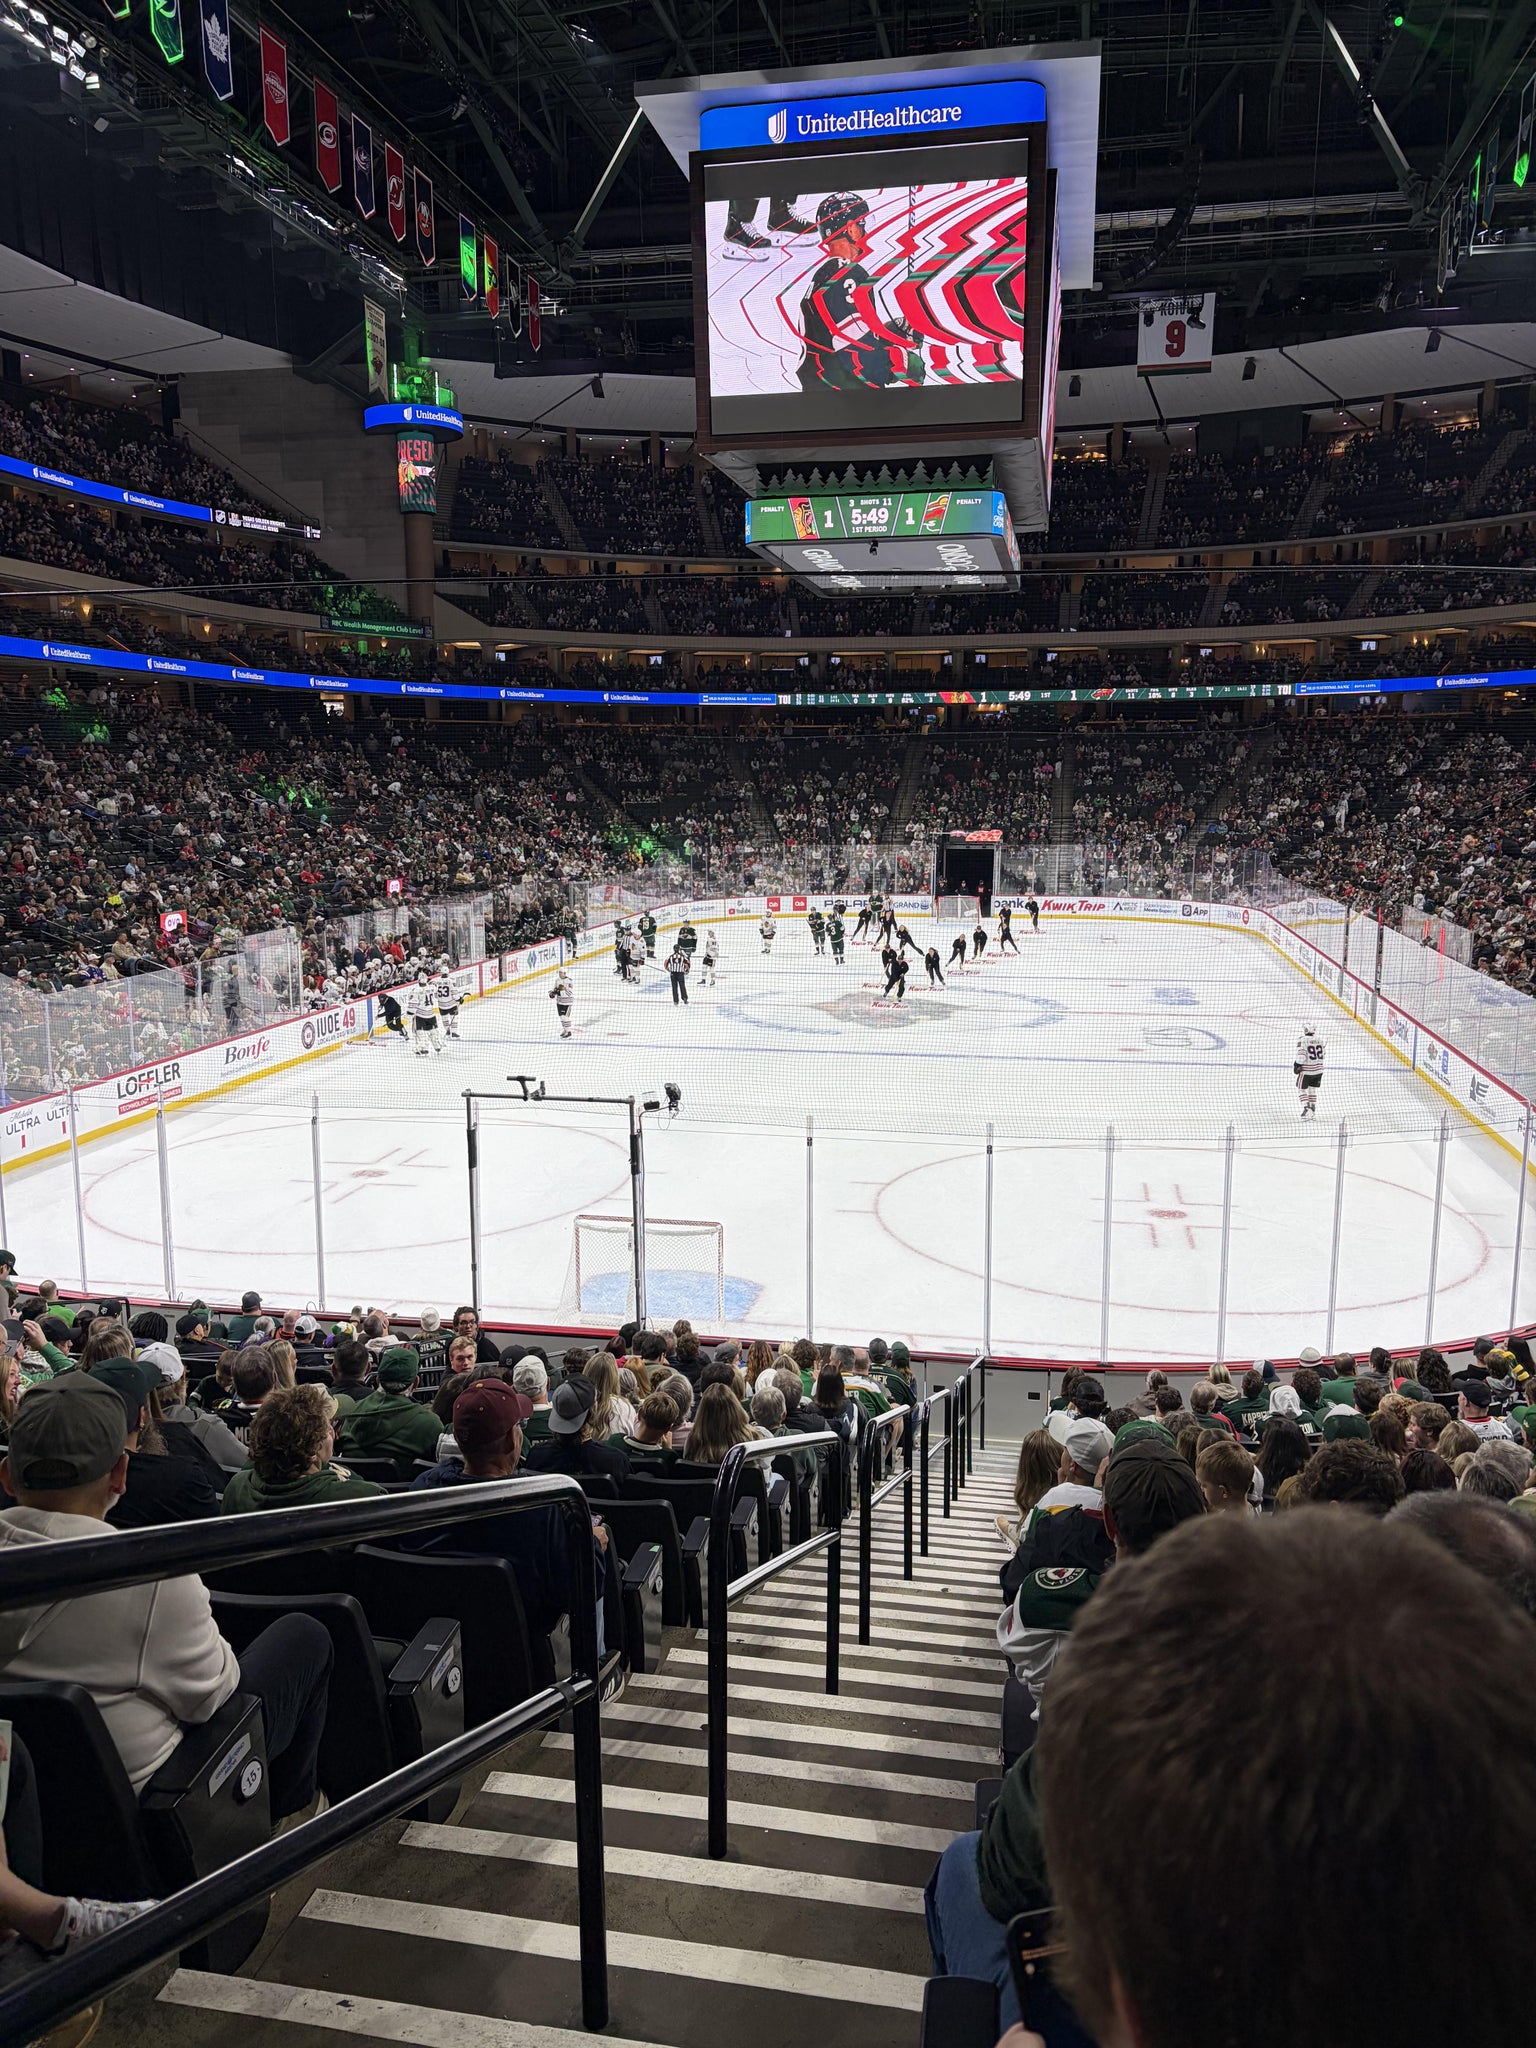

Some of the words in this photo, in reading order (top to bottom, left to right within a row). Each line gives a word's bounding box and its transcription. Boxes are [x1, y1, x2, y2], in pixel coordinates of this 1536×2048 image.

[796, 106, 962, 135] UnitedHealthcare
[1165, 320, 1186, 357] 9
[849, 499, 855, 508] 3
[882, 498, 892, 506] 11
[956, 497, 982, 505] PENALTY
[824, 510, 834, 528] 1
[851, 507, 889, 525] 5:49
[905, 507, 915, 525] 1
[852, 526, 864, 534] 1ST
[864, 525, 888, 533] PERIOD
[343, 620, 361, 629] Wealth
[362, 623, 395, 632] Management
[396, 625, 408, 633] Club
[1008, 691, 1031, 701] 5:49
[1070, 690, 1077, 701] 1
[1277, 685, 1291, 695] TOI
[778, 695, 792, 705] TOI
[980, 692, 987, 702] 1
[1041, 900, 1076, 911] KWIK
[1077, 900, 1106, 912] TRIP
[1227, 911, 1241, 920] BMO
[830, 926, 836, 936] 3
[538, 946, 557, 964] TRIA
[438, 986, 450, 998] 53
[317, 1012, 340, 1038] IUOE
[342, 1007, 356, 1028] 49
[224, 1036, 270, 1065] Bonfe
[1307, 1045, 1323, 1060] 92
[117, 1062, 181, 1099] LOFFLER
[6, 1116, 41, 1135] ULTRA
[452, 1674, 459, 1686] 14
[247, 1769, 257, 1788] 15
